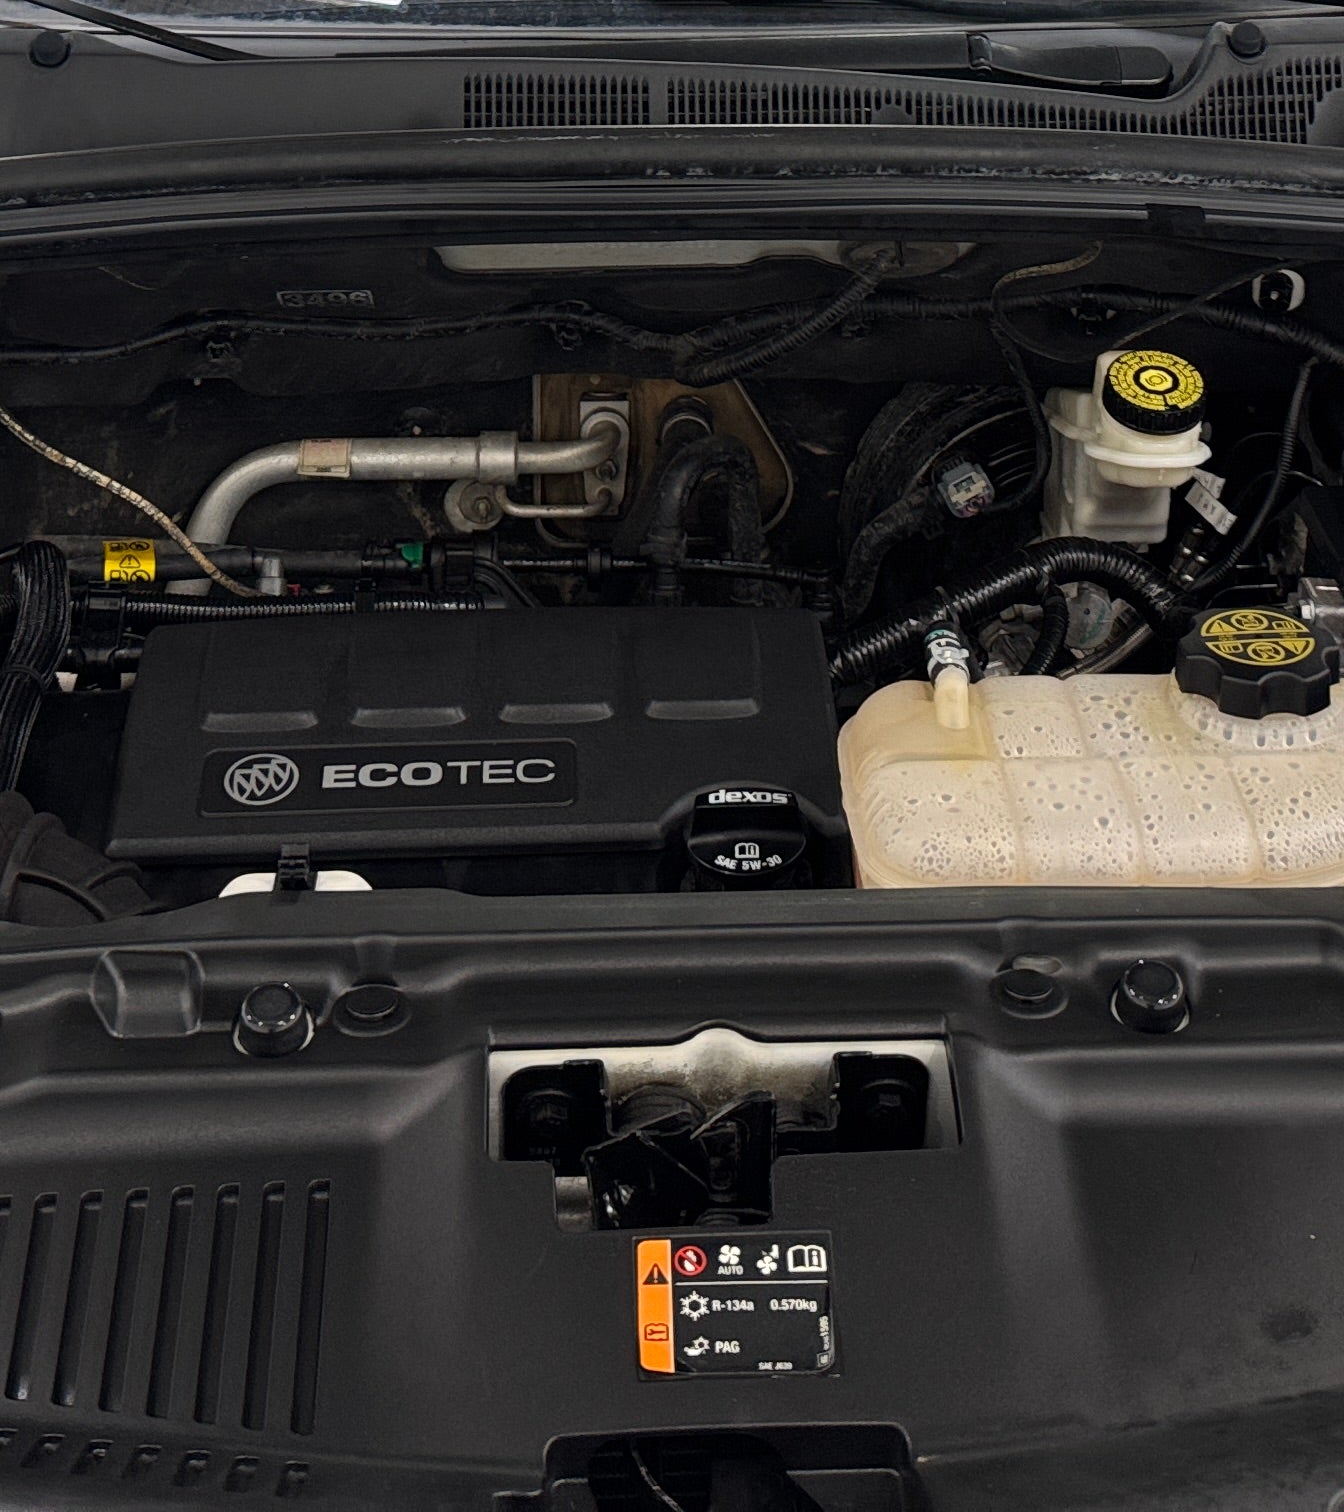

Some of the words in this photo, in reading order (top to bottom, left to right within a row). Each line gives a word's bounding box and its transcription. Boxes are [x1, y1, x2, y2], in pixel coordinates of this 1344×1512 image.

[322, 759, 555, 788] ECOTEC
[708, 789, 788, 804] dexos
[714, 855, 738, 869] SAE
[742, 854, 782, 870] 5W-30
[717, 1265, 744, 1275] AUTO
[712, 1299, 755, 1311] R-134a
[769, 1298, 818, 1312] 0.570kg
[715, 1341, 741, 1354] PAG
